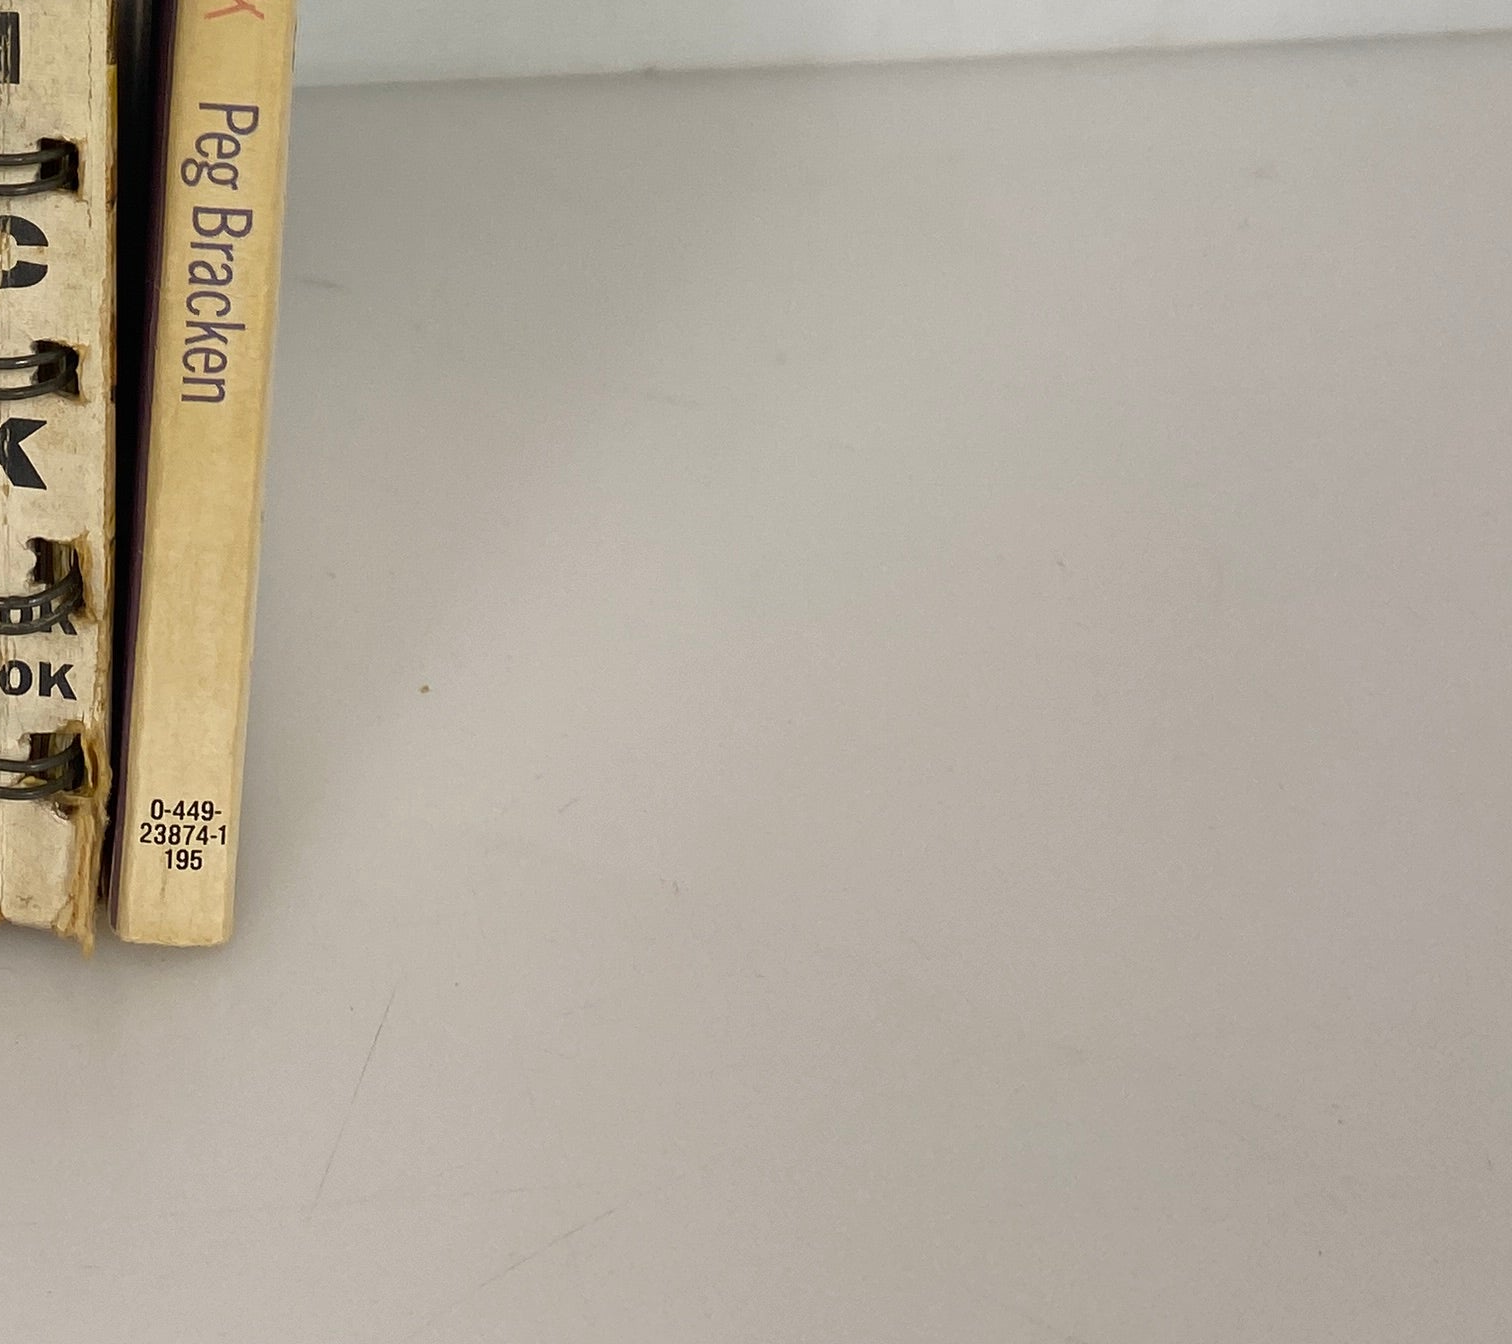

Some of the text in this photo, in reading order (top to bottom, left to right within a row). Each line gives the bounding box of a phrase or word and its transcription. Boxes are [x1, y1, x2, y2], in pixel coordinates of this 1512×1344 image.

[180, 101, 260, 404] Peg Bracken
[150, 798, 222, 822] 0-449-
[139, 822, 227, 846] 23874-1
[164, 848, 203, 871] 195
